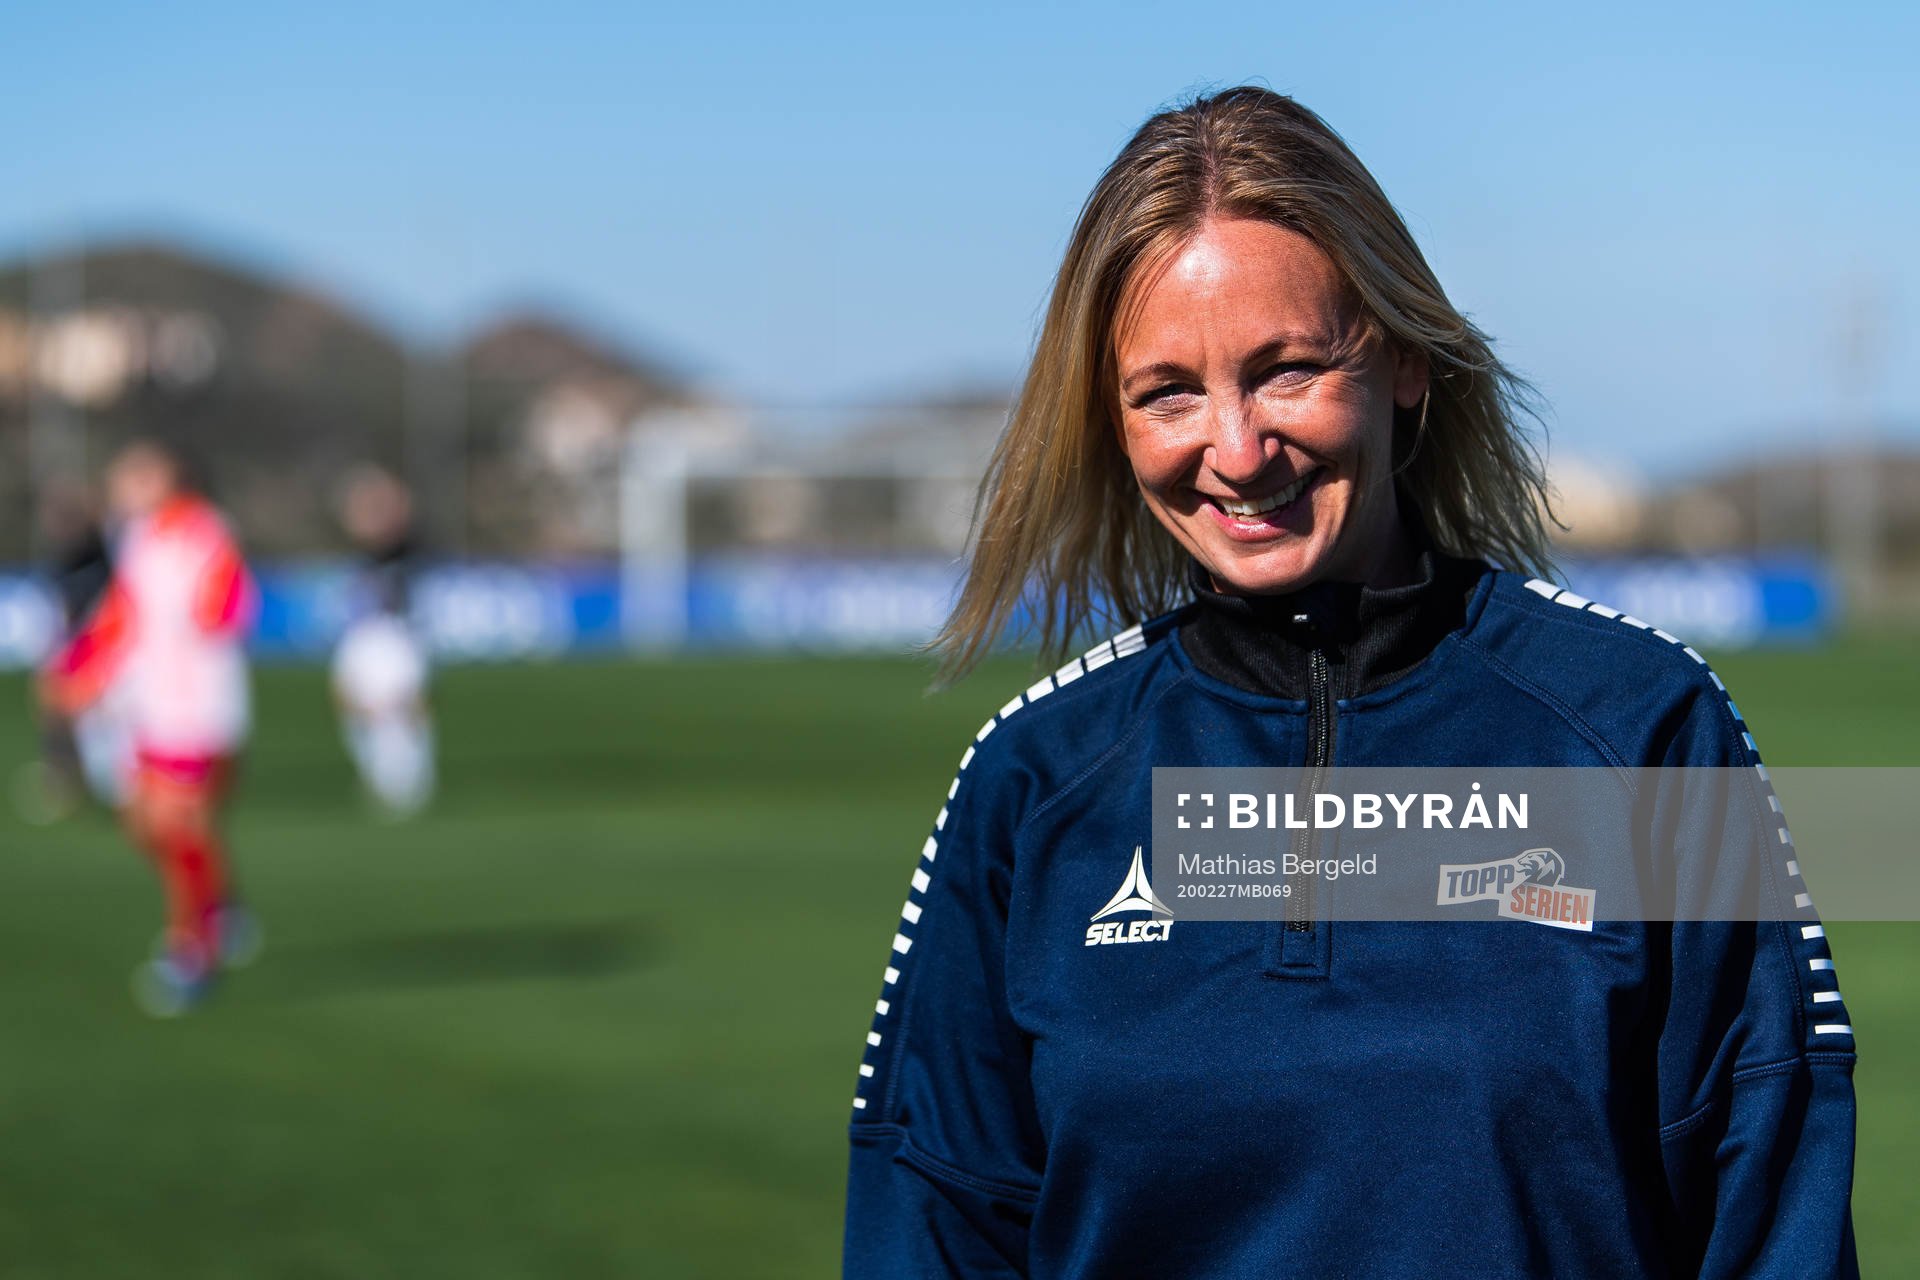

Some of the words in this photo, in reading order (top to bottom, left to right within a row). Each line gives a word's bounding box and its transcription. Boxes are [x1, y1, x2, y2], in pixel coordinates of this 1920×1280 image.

[1446, 865, 1515, 897] TOPP
[1511, 885, 1589, 925] SERIEN
[1084, 920, 1174, 947] SELECT
